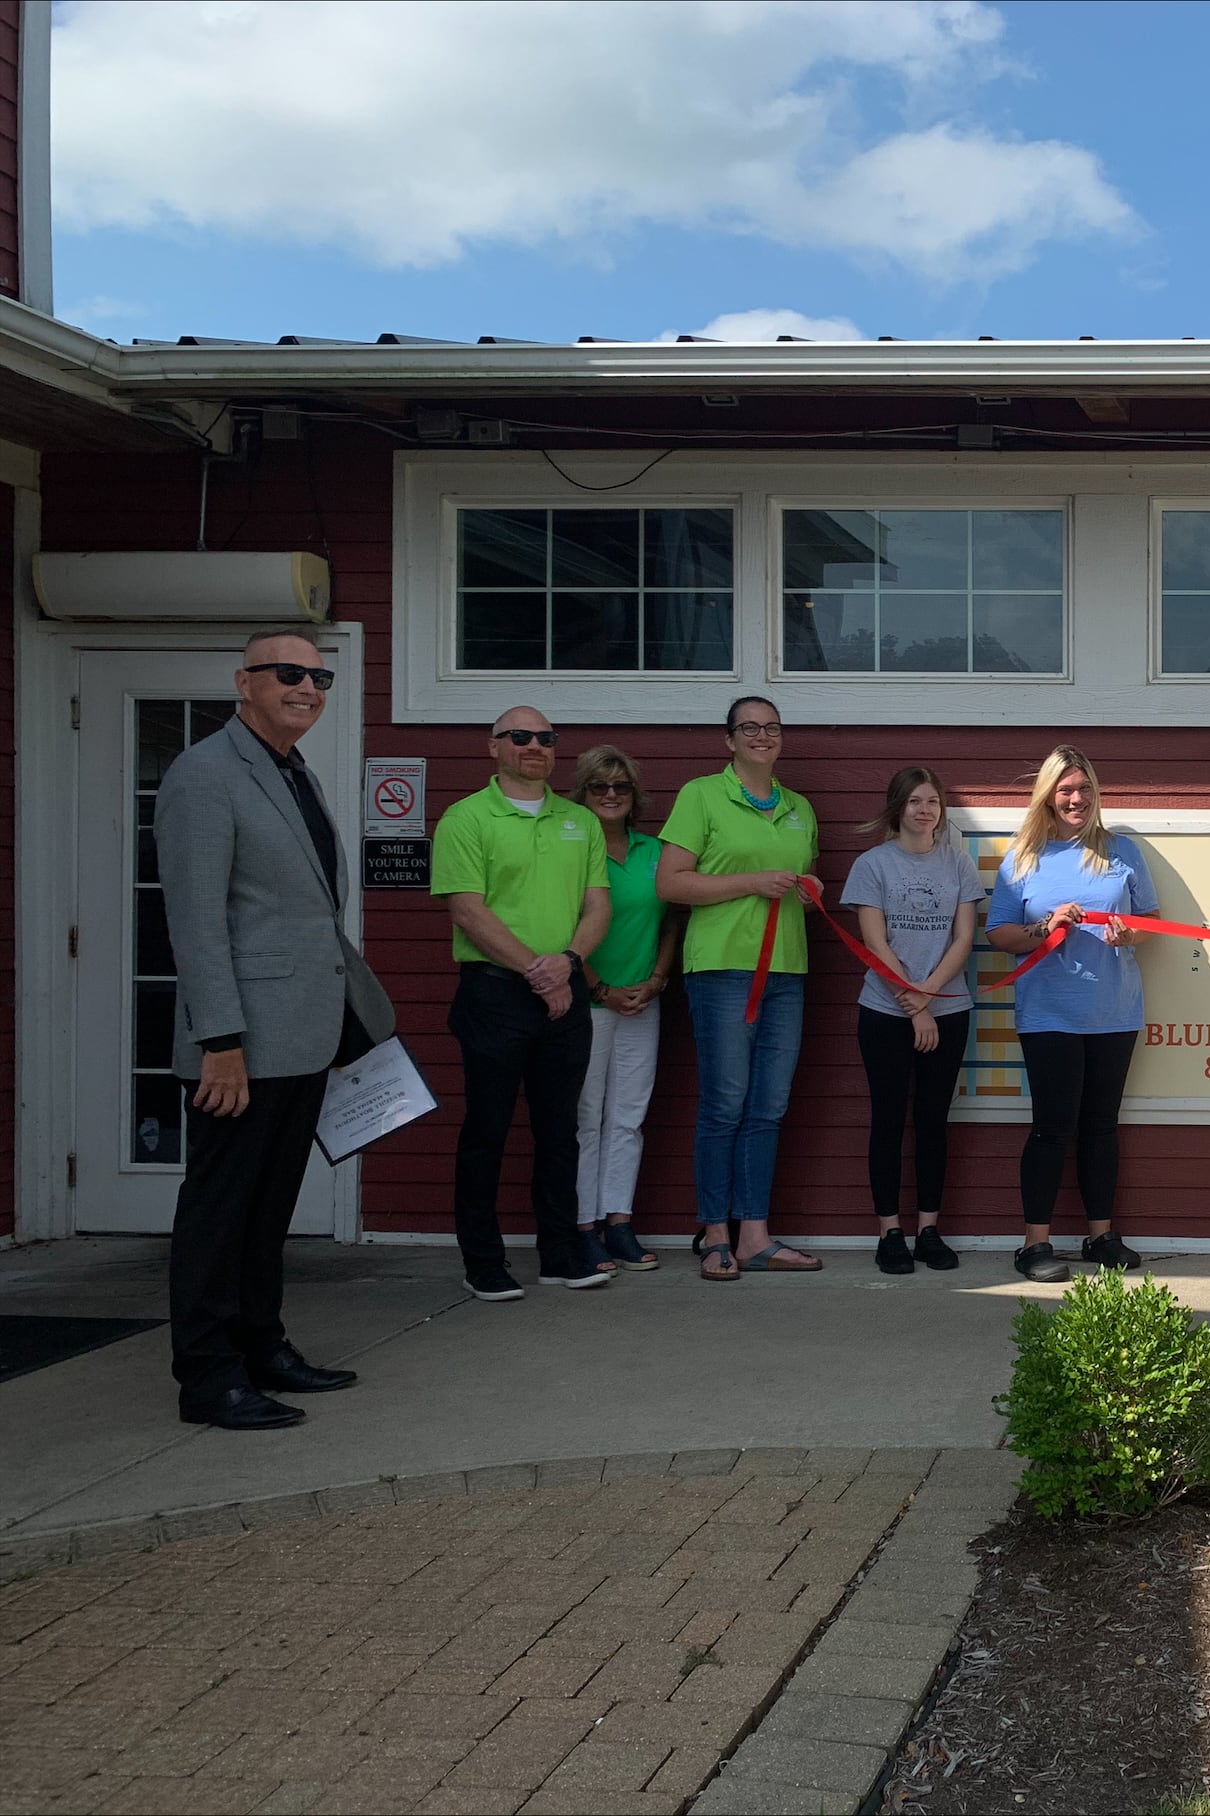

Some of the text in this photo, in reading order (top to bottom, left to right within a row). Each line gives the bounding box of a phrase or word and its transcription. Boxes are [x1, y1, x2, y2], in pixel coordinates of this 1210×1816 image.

[380, 844, 414, 855] SMILE
[368, 857, 427, 868] YOU'RE ON
[373, 871, 421, 881] CAMERA
[900, 922, 930, 931] MARINA
[931, 923, 948, 931] BAR
